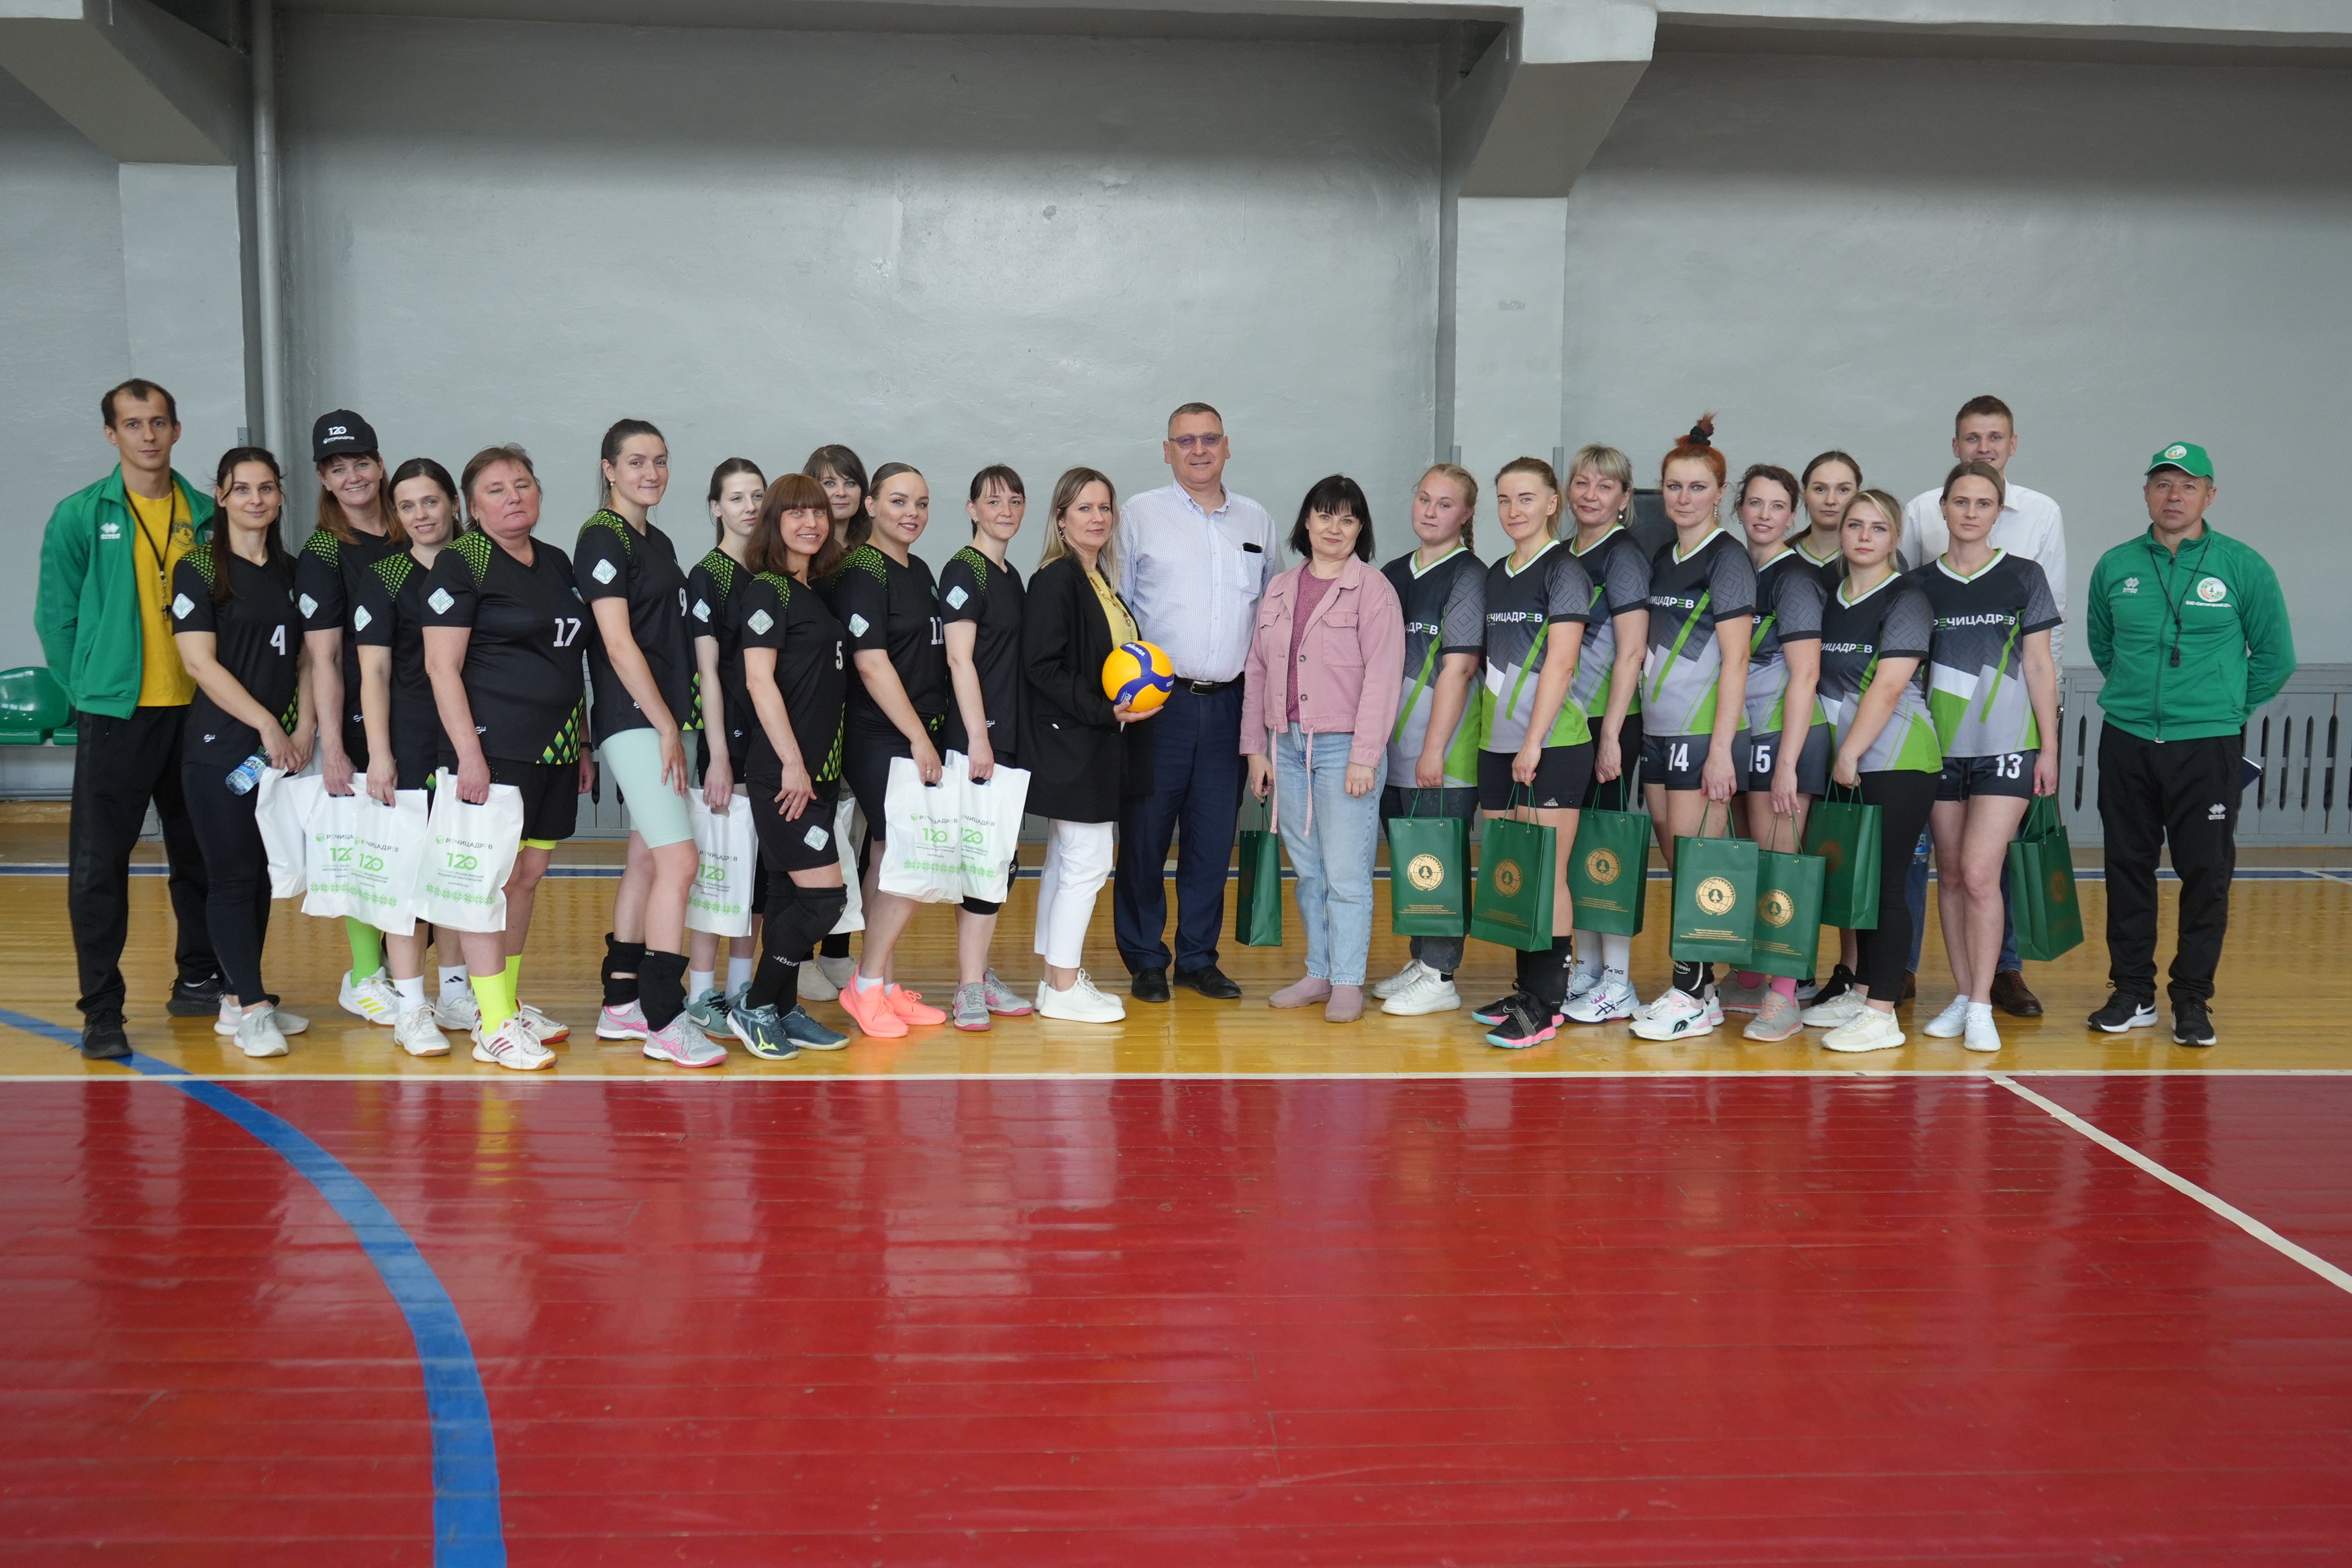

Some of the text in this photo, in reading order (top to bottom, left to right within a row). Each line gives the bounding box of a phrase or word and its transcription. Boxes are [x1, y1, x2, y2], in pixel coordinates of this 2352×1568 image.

[328, 426, 347, 436] 120
[1650, 595, 1694, 609] ИЦАДРЕВ
[553, 618, 582, 647] 17
[930, 616, 944, 645] 11
[269, 624, 286, 656] 4
[1820, 642, 1873, 654] ИЦАДРЕВ
[836, 640, 844, 671] 5
[1668, 742, 1689, 772] 14
[1996, 753, 2023, 779] 13
[446, 838, 493, 850] РЕЧИЦАДРЕВ
[330, 847, 354, 862] 12
[360, 853, 384, 871] 120
[446, 852, 478, 870] 120
[699, 864, 725, 881] 120
